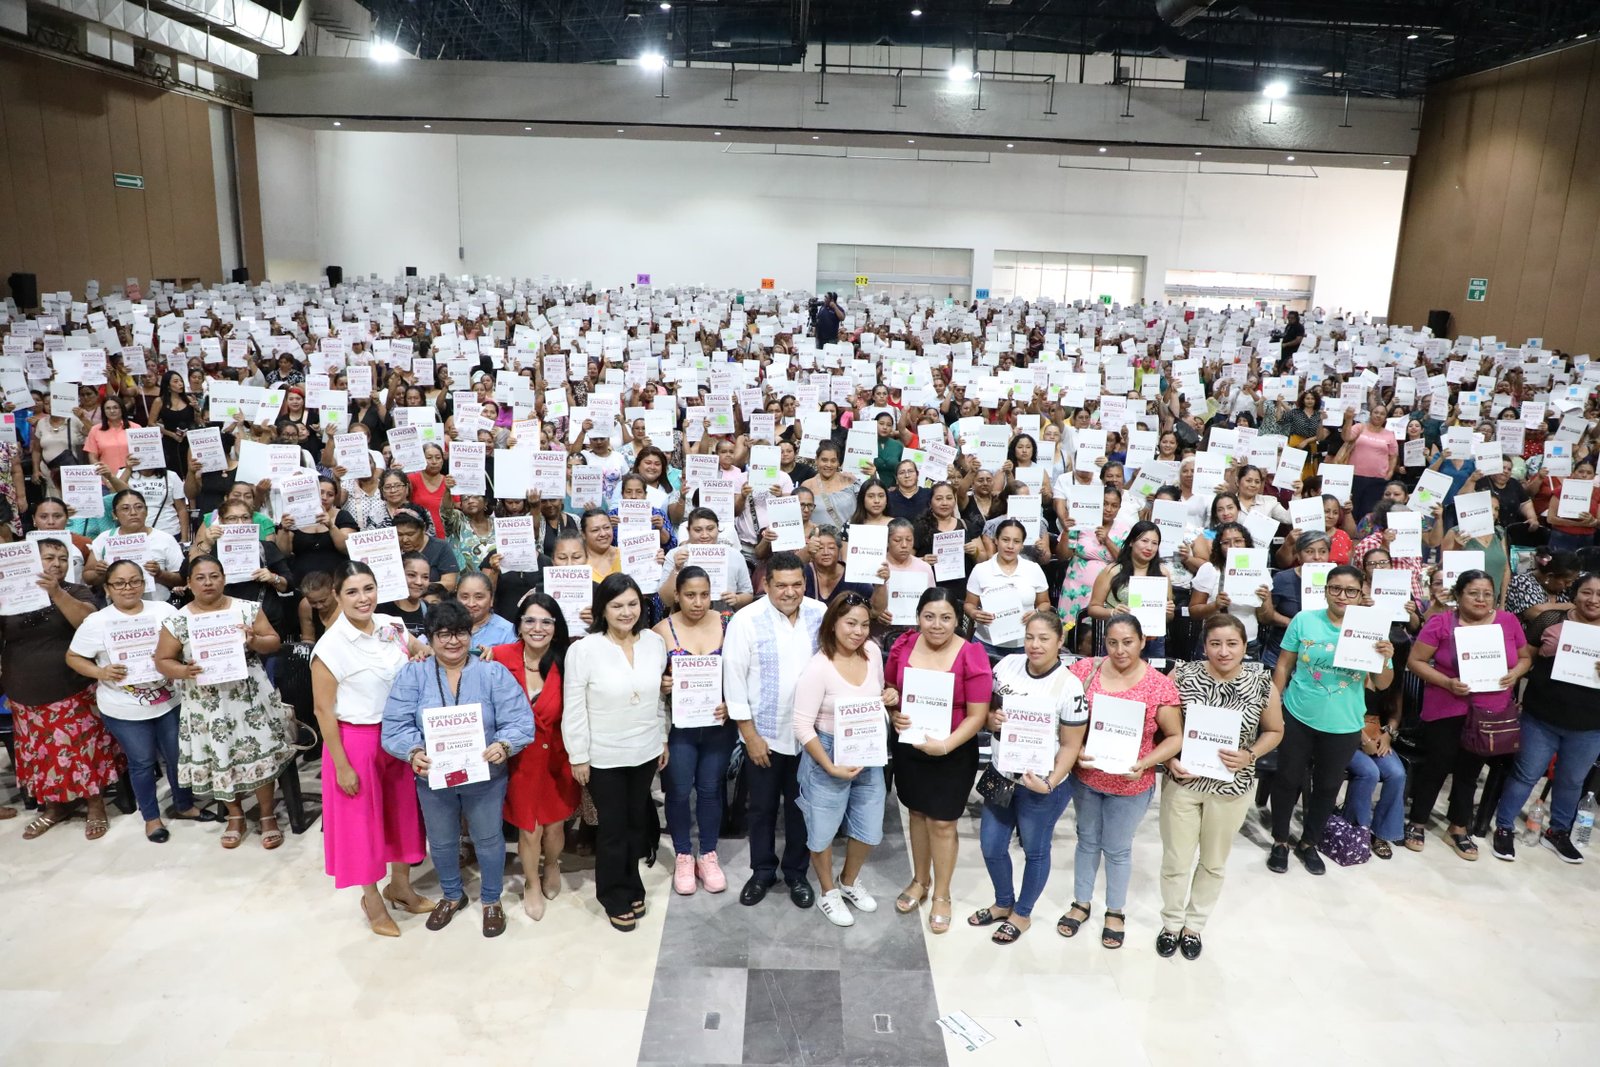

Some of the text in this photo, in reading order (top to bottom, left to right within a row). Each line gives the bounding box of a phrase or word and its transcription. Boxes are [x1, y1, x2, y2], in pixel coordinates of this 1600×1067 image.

[390, 428, 416, 437] TANDAS
[191, 437, 219, 446] TANDAS
[336, 434, 364, 442] TANDAS
[931, 443, 955, 456] TANDAS
[282, 480, 315, 488] TANDAS
[621, 502, 651, 510] TANDAS
[497, 521, 531, 529] TANDAS
[221, 527, 257, 535] TANDAS
[106, 538, 145, 547] TANDAS
[353, 533, 395, 546] TANDAS
[622, 536, 656, 548] TANDAS
[549, 572, 590, 580] TANDAS
[1003, 609, 1021, 617] MUJER
[111, 631, 156, 641] TANDAS
[193, 628, 237, 639] TANDAS
[675, 660, 718, 669] TANDAS
[838, 702, 873, 710] CERTIFICADO
[840, 705, 881, 716] TANDAS
[428, 712, 468, 721] CERTIFICADO
[1006, 708, 1041, 716] CERTIFICADO
[429, 716, 478, 729] TANDAS
[1006, 712, 1051, 724] TANDAS
[1114, 728, 1137, 738] MUJER
[1209, 737, 1233, 746] MUJER
